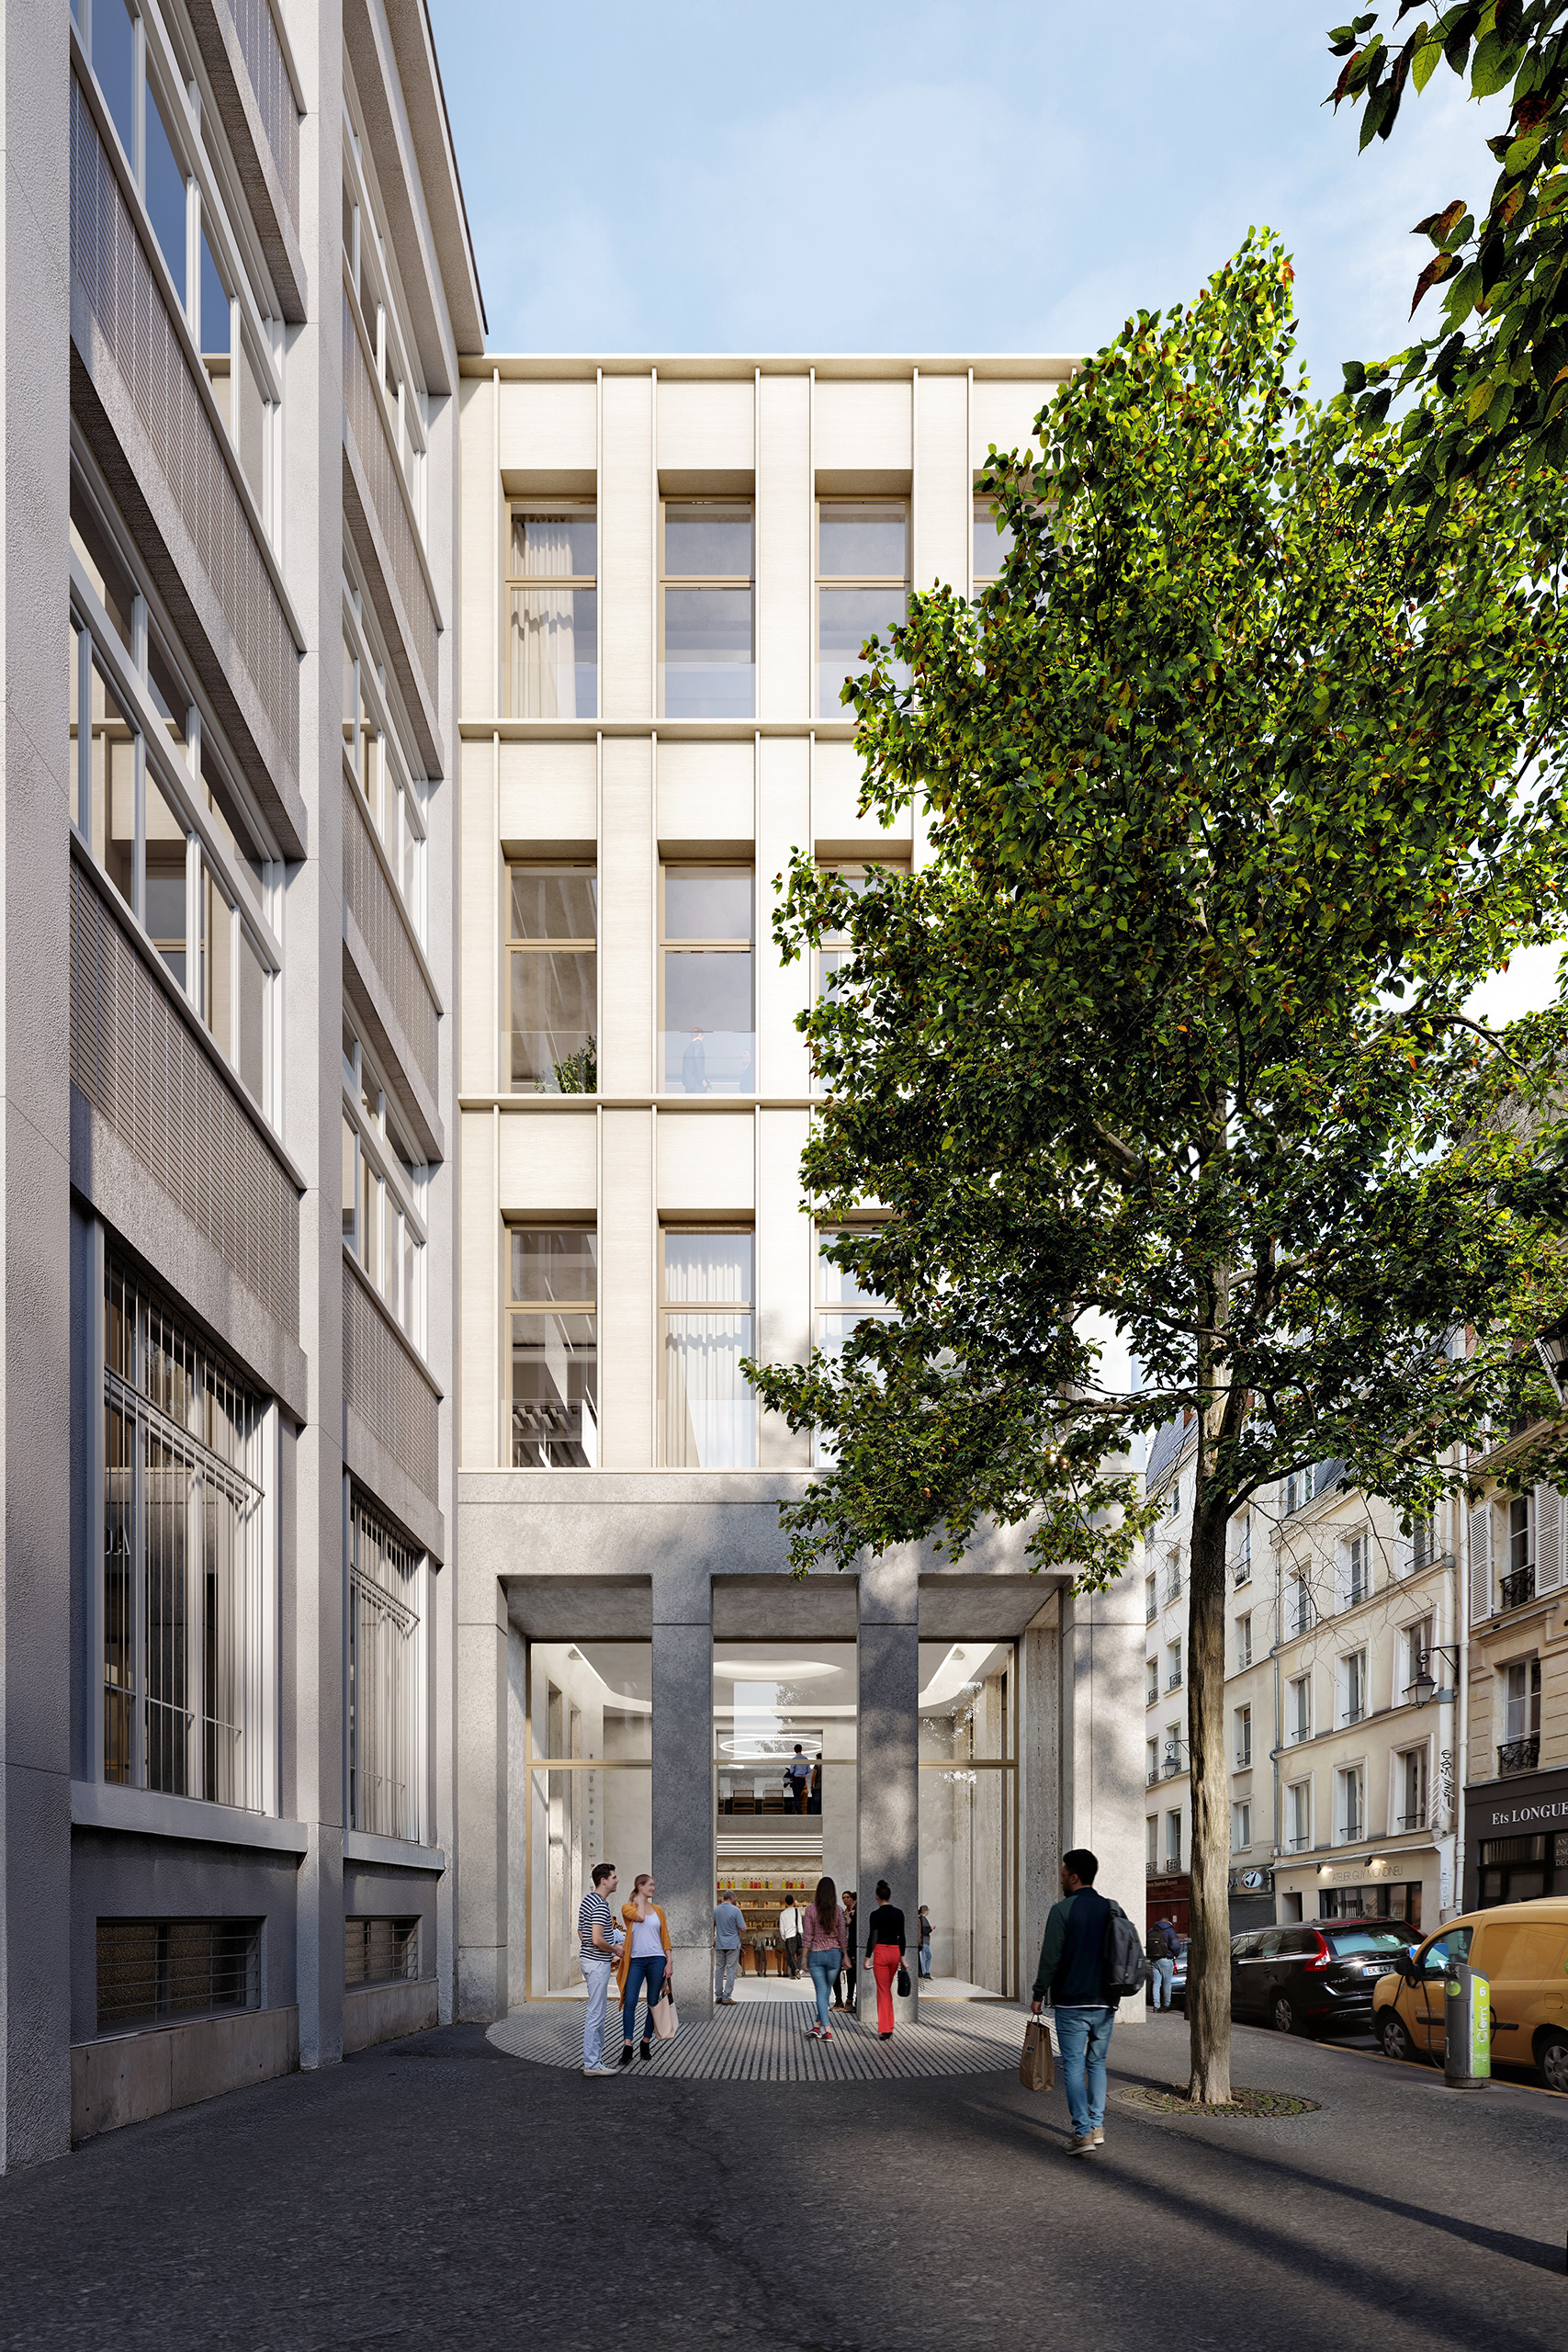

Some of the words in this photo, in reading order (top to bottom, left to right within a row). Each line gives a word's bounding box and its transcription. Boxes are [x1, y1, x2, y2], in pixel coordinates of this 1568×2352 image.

[1491, 1812, 1509, 1826] Ets
[1511, 1801, 1568, 1823] LONGUE
[1352, 1868, 1367, 1881] GUY
[1478, 1986, 1486, 1996] 6
